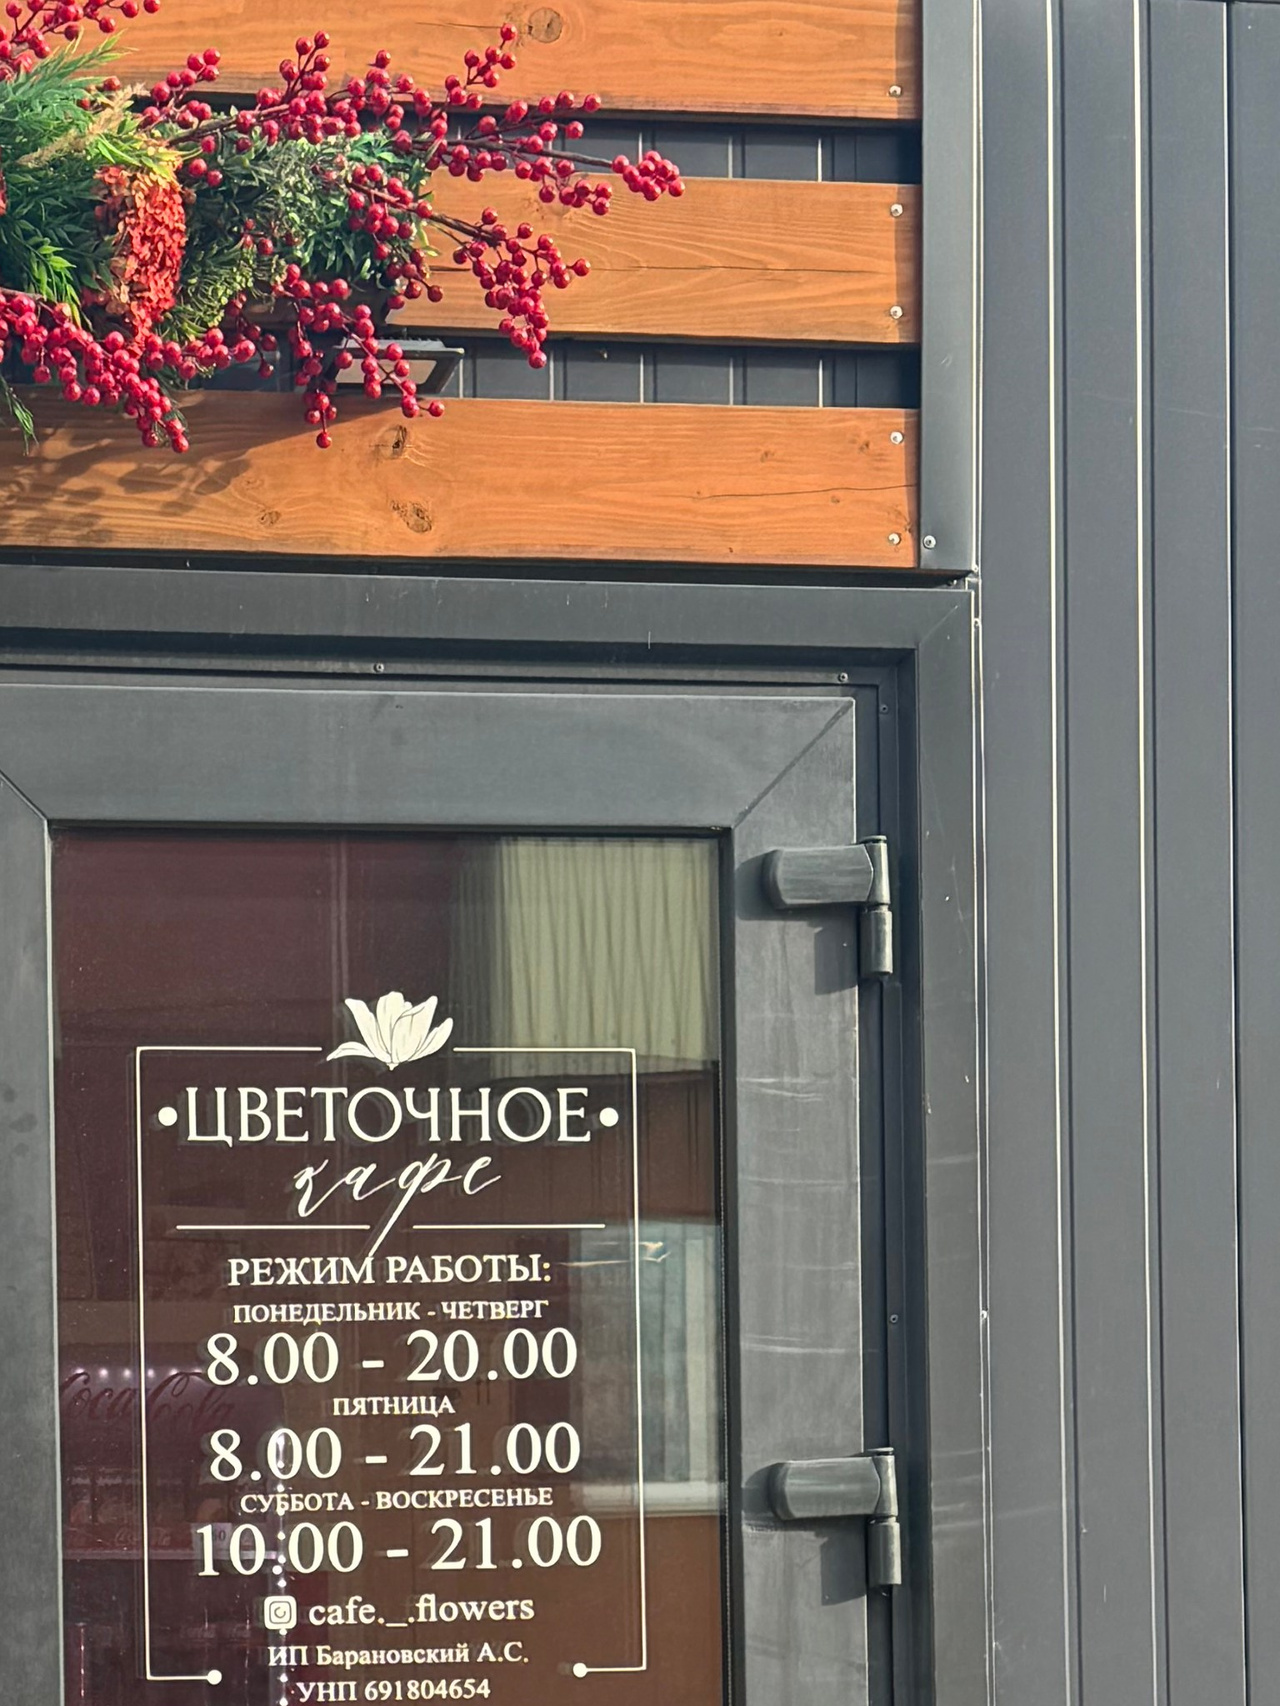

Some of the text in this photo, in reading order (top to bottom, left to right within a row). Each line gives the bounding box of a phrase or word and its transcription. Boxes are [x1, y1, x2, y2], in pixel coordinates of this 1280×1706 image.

[186, 1087, 590, 1147] ЦВЕТОЧНОЕ
[293, 1153, 503, 1257] кафе
[228, 1254, 550, 1285] РЕЖИМ РАБОТЫ:
[234, 1302, 420, 1325] ПОНЕДЕЛЬНИК
[441, 1300, 548, 1319] ЧЕТВЕРГ
[207, 1332, 338, 1385] 8.00
[407, 1328, 577, 1381] 20.00
[333, 1396, 455, 1417] ПЯТНИЦА
[211, 1428, 341, 1481] 8.00
[409, 1422, 580, 1475] 21.00
[239, 1492, 354, 1513] СУББОТА
[376, 1488, 553, 1509] ВОСКРЕСЕНЬЕ
[197, 1522, 363, 1576] 10.00
[431, 1515, 601, 1569] 21.00
[268, 1642, 528, 1669] ИП Барановский А.С.
[296, 1679, 490, 1702] УНП 691804654
